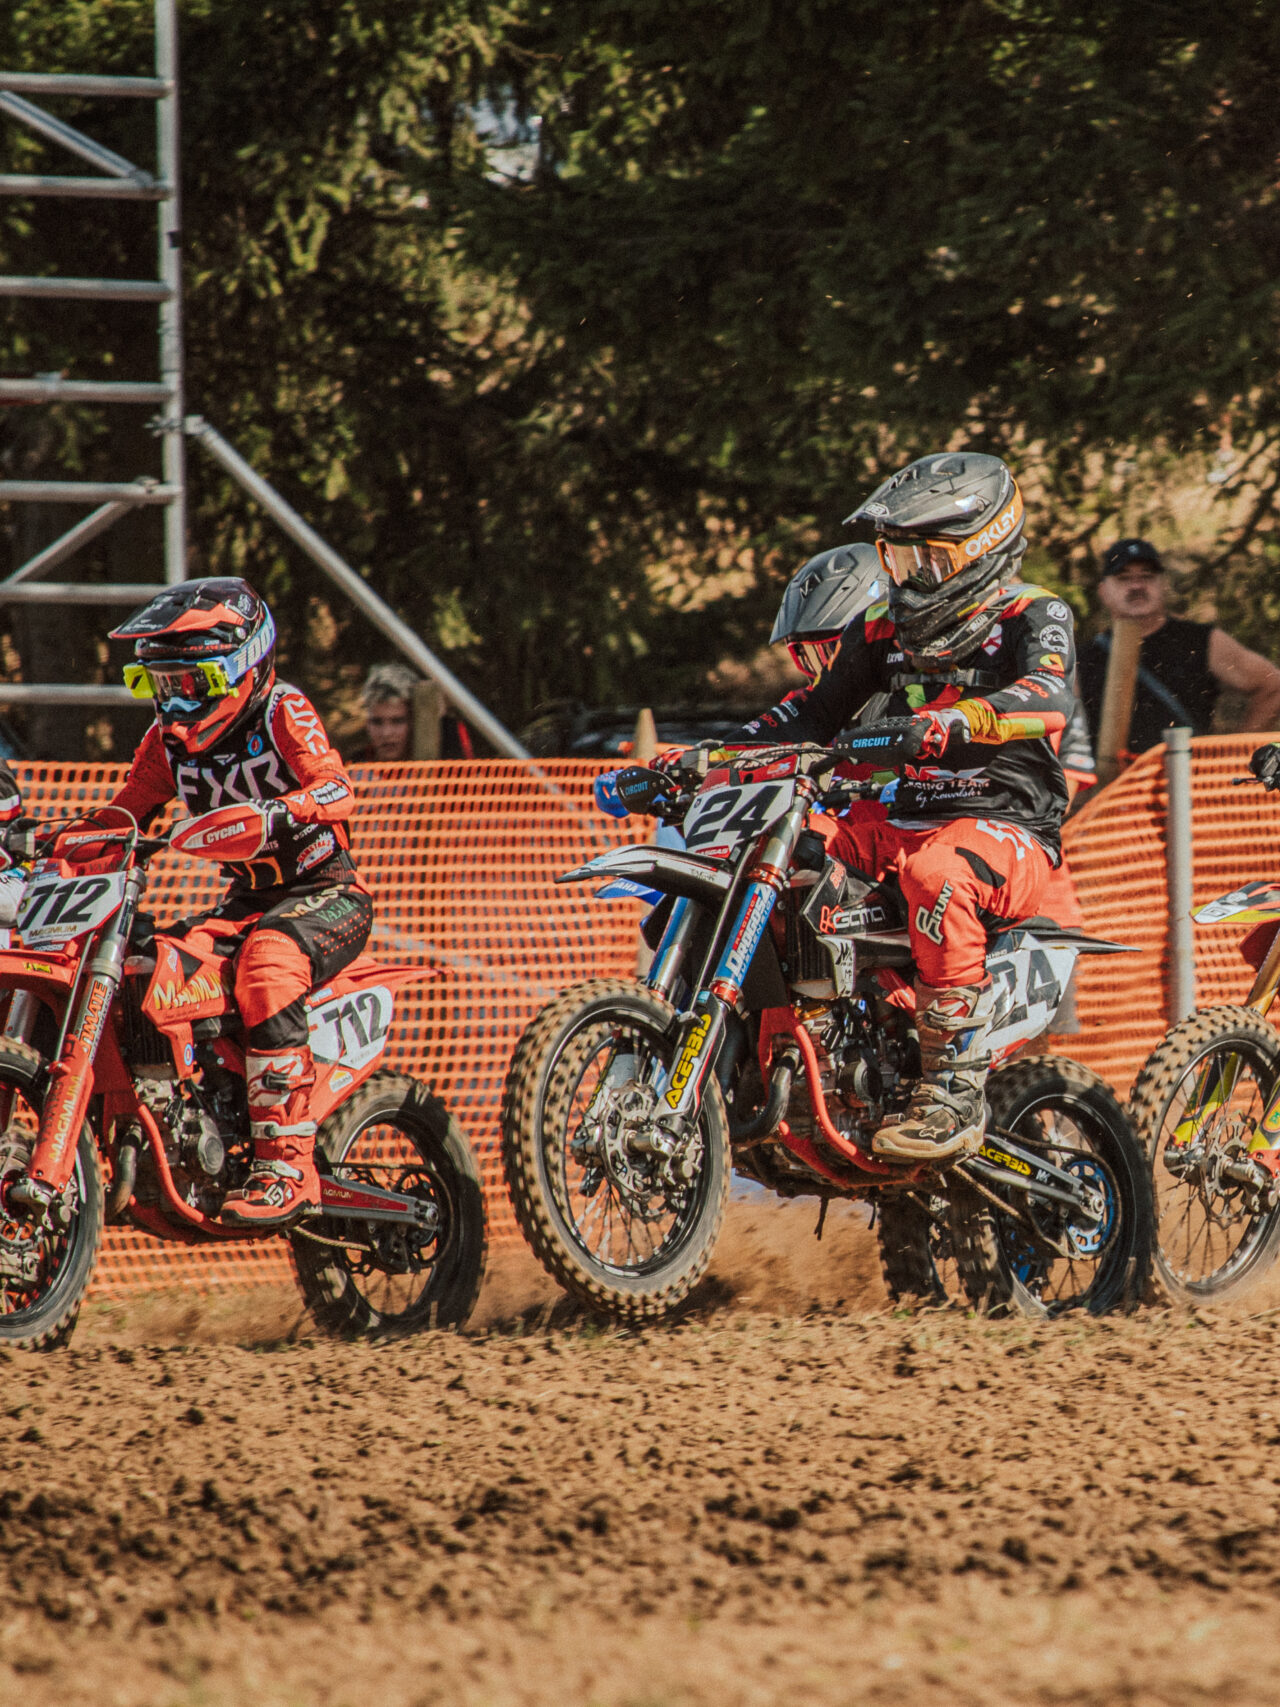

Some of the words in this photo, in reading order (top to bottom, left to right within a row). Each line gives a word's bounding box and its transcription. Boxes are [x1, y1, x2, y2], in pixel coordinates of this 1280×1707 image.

[965, 506, 1015, 556] OAKLEY
[852, 736, 891, 749] CIRCUIT
[177, 750, 289, 808] FXR
[625, 781, 649, 796] CIRCUIT
[207, 822, 246, 844] CYCRA
[685, 785, 783, 849] 24
[18, 877, 112, 931] 712
[725, 885, 770, 977] DROGOSZ
[322, 992, 389, 1058] 712
[665, 1013, 712, 1109] ACERBIS
[979, 1144, 1032, 1176] ACERBIS
